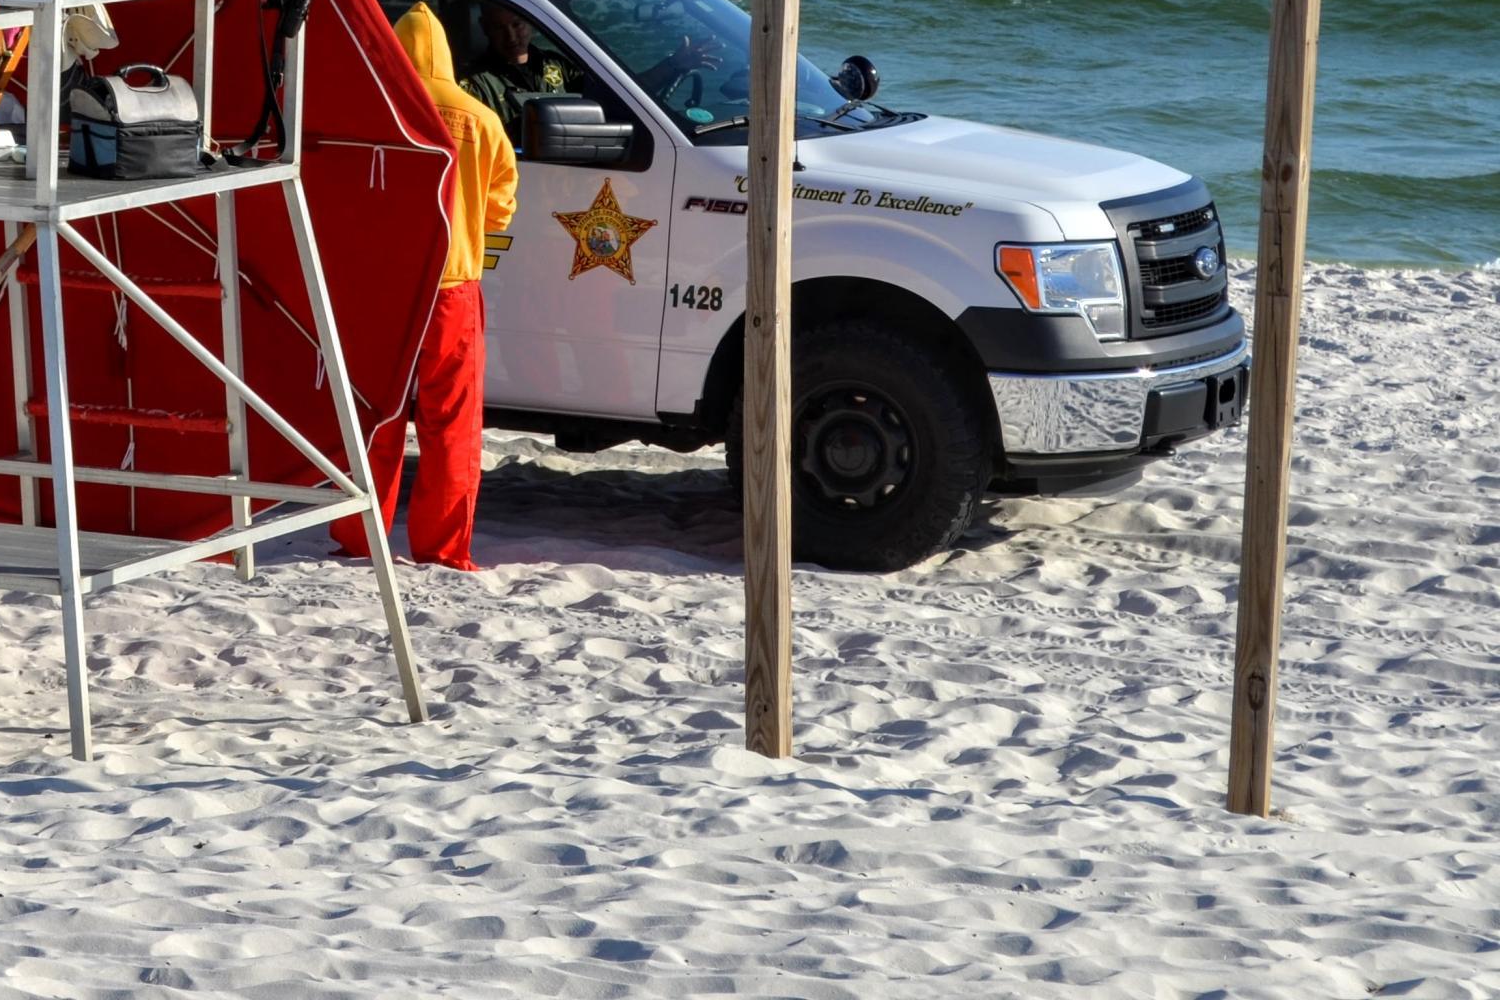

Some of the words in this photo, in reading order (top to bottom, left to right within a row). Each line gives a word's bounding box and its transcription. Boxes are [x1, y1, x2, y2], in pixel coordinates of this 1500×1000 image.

[734, 175, 846, 203] "Citment
[852, 188, 871, 206] To
[875, 191, 974, 217] Excellence"
[670, 283, 723, 311] 1428
